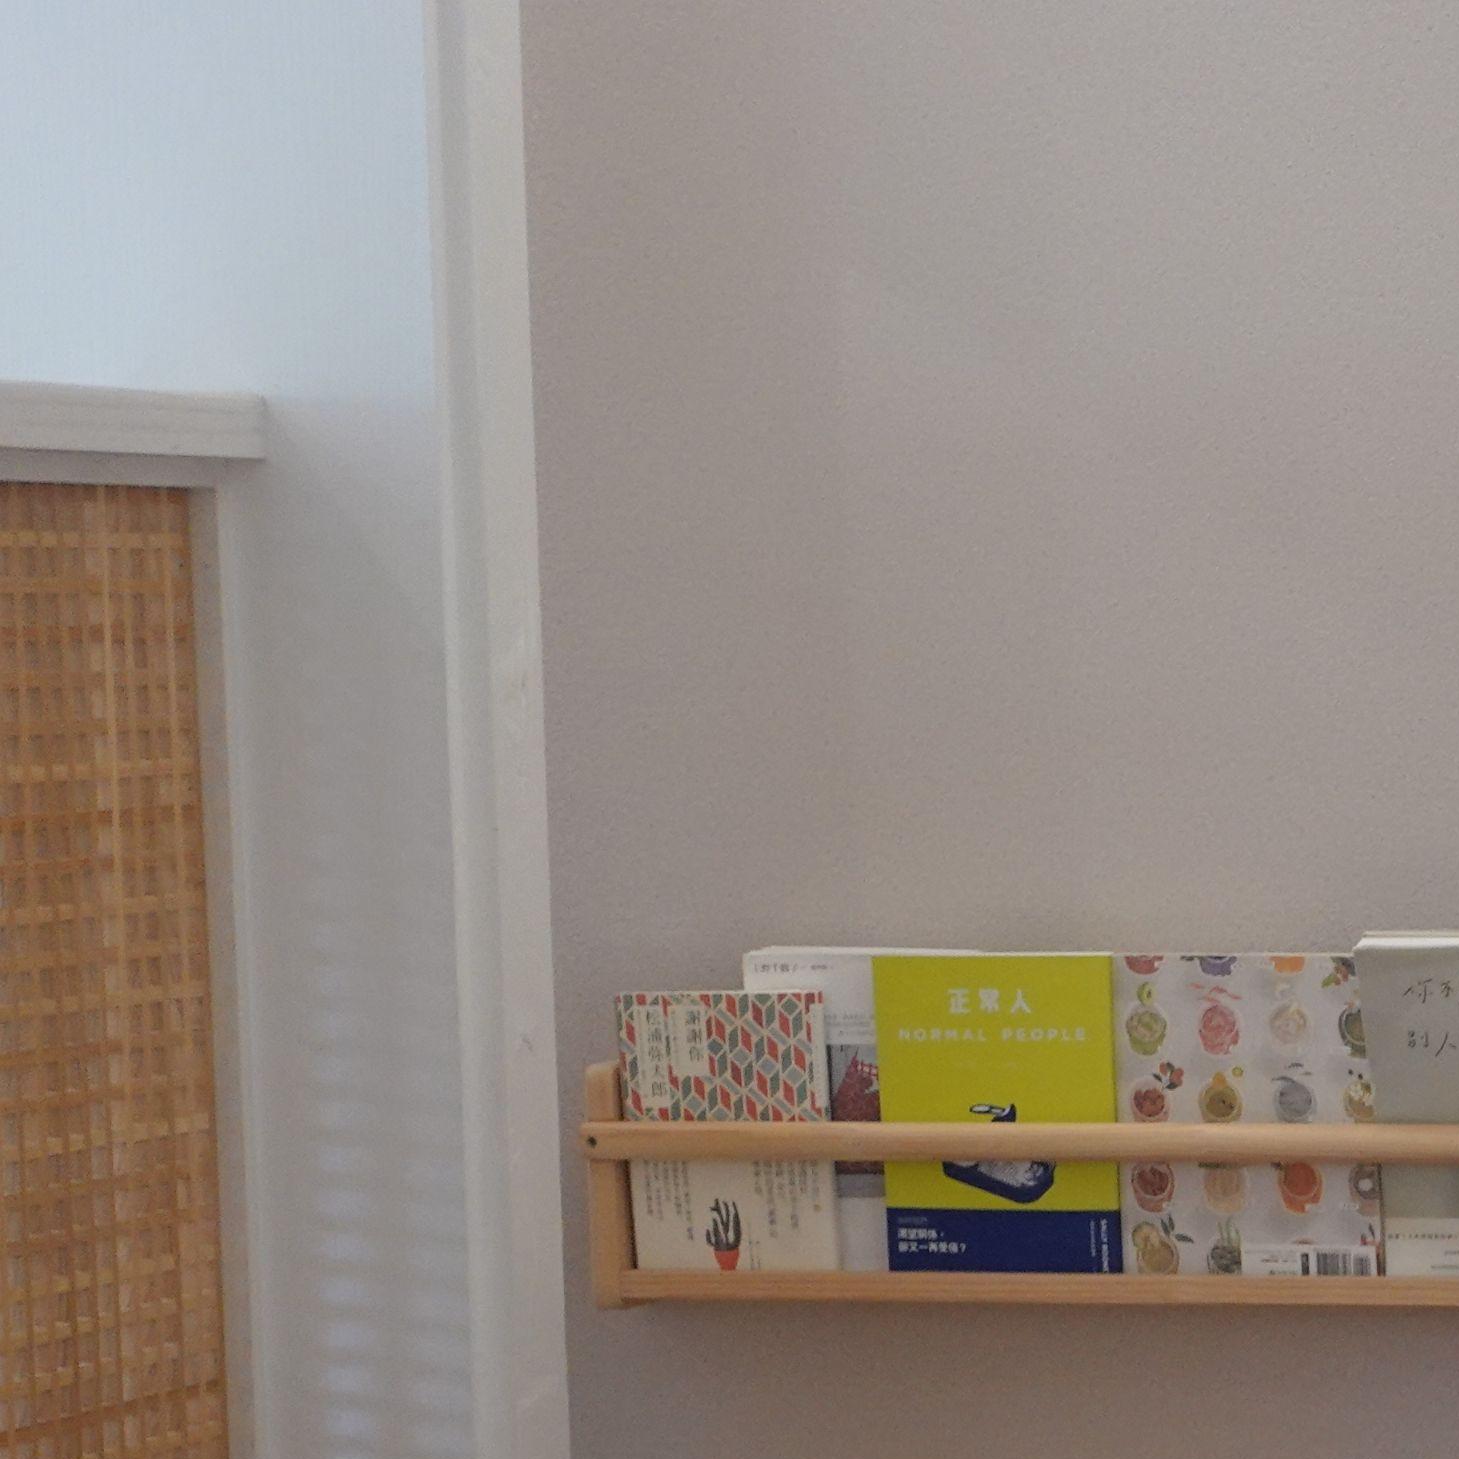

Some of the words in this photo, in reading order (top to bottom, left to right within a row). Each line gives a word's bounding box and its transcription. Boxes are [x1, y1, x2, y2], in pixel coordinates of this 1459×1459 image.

[948, 988, 1032, 1015] 正常人
[898, 1027, 987, 1042] NORMAL
[1001, 1026, 1087, 1042] PEOPLE
